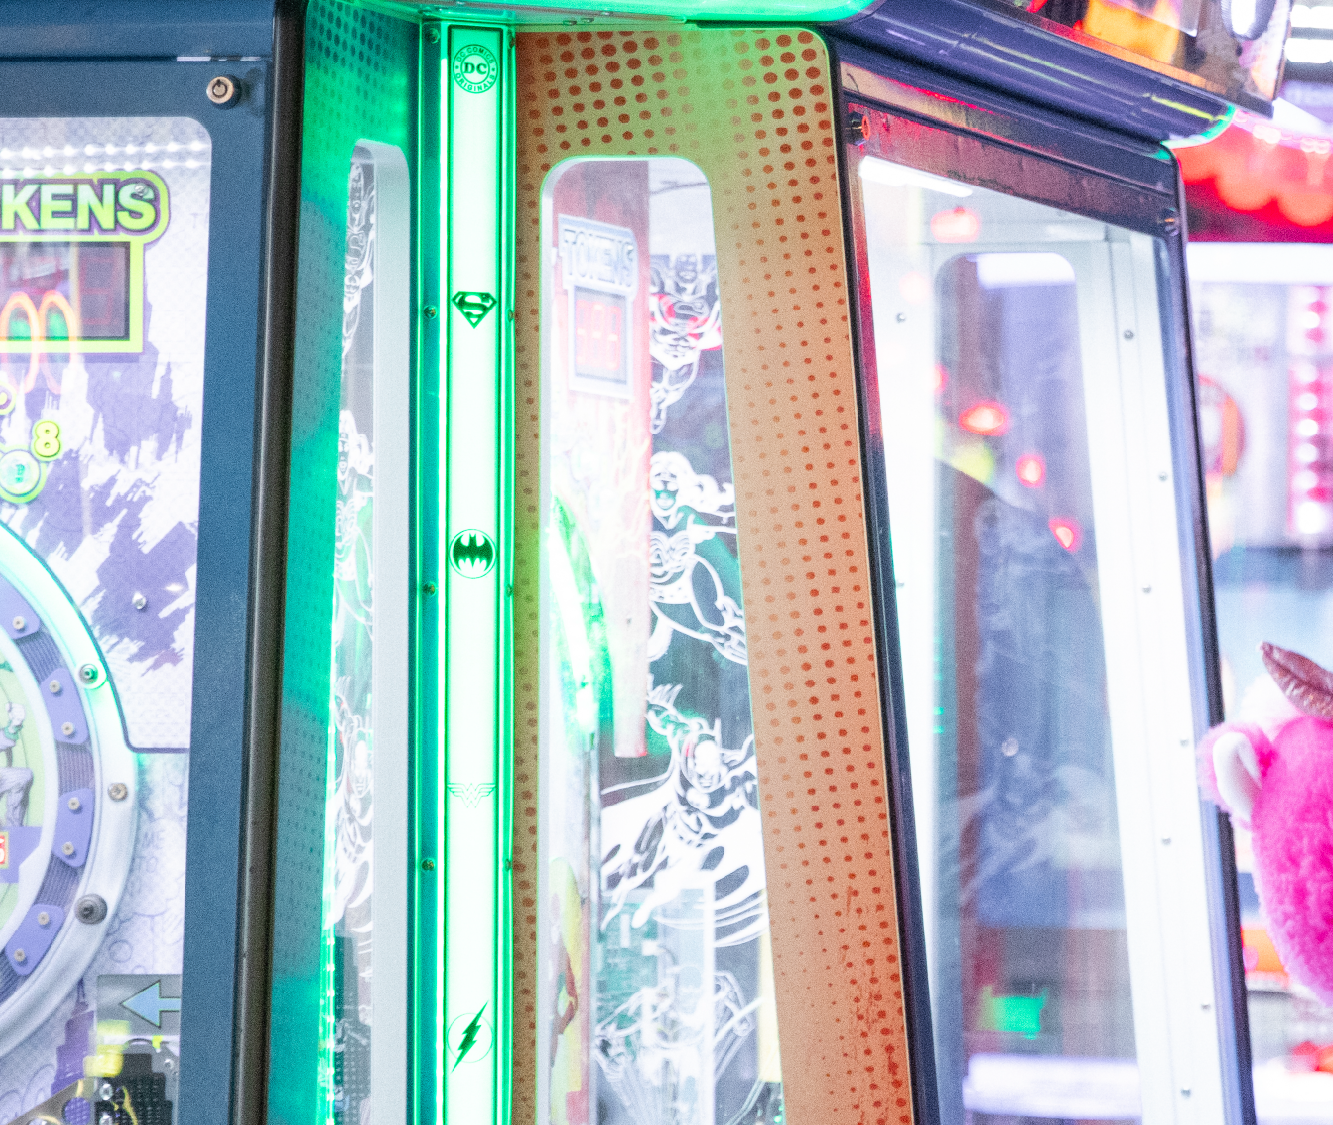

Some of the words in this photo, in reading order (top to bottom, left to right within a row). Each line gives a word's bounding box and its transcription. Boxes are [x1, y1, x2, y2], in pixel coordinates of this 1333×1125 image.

[455, 72, 495, 92] ORIGINALS
[463, 62, 487, 75] DC
[2, 182, 157, 231] KENS
[34, 421, 60, 458] 8
